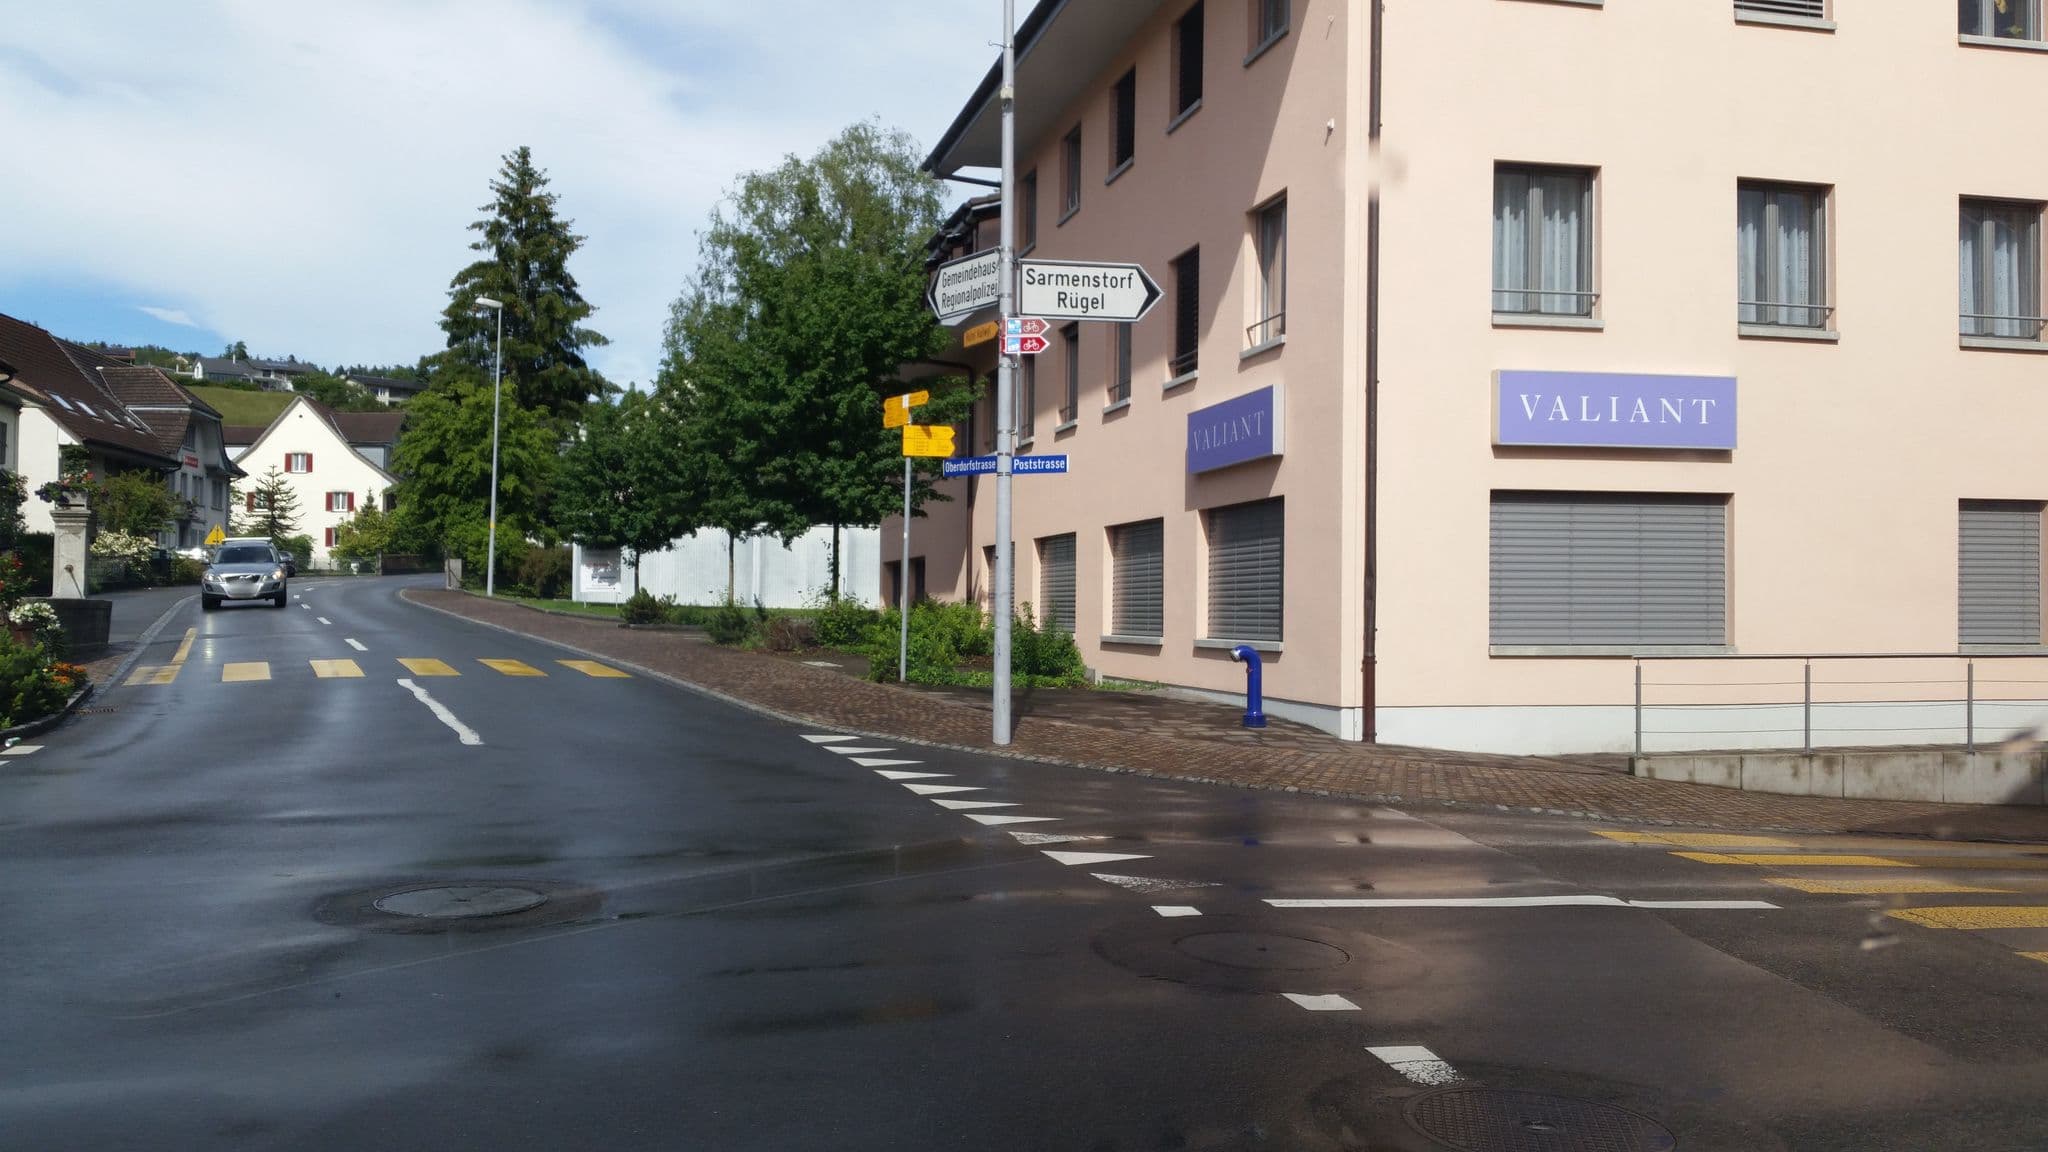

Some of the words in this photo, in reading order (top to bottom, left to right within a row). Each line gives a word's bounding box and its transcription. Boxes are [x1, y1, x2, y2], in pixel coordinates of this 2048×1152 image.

[942, 261, 997, 288] Gemeindehaus
[1026, 268, 1134, 289] Sarmenstorf
[941, 279, 998, 311] Regionalpolizei
[1057, 291, 1105, 313] Rügel
[1519, 393, 1718, 425] VALIANT
[1193, 410, 1265, 452] VALIANT
[945, 459, 996, 473] Oberdorfstrasse
[1013, 459, 1065, 470] Poststrasse
